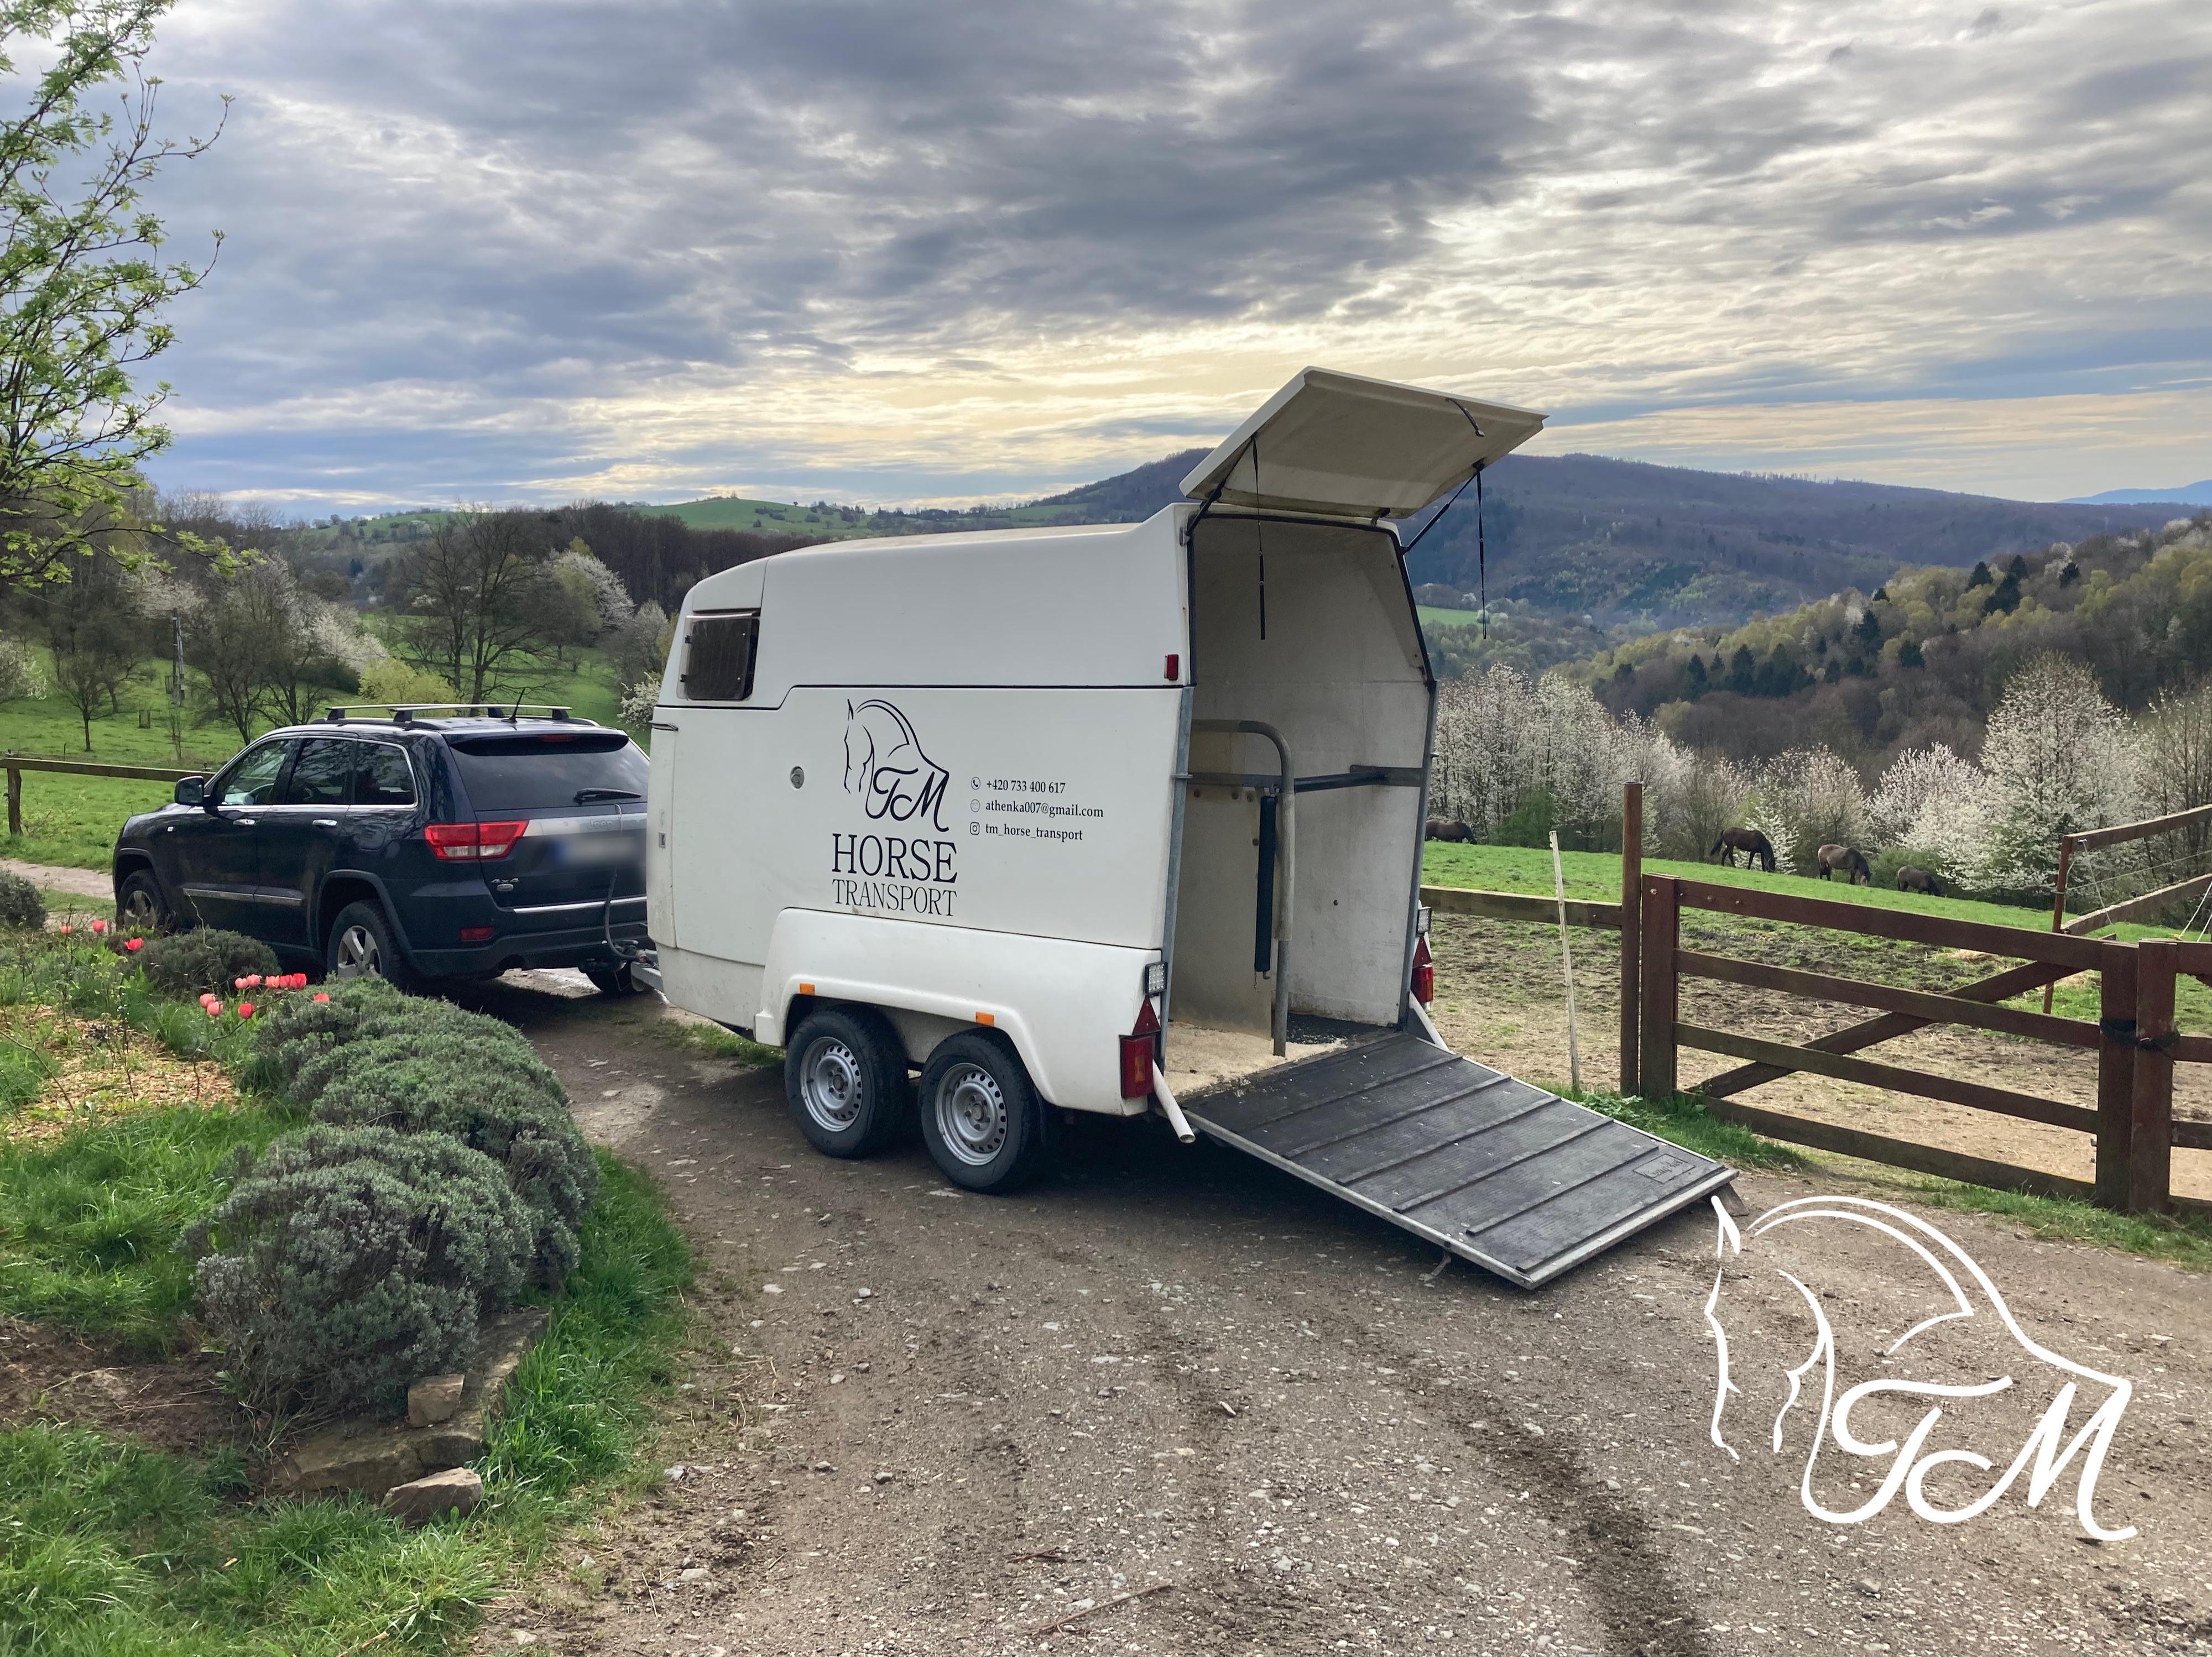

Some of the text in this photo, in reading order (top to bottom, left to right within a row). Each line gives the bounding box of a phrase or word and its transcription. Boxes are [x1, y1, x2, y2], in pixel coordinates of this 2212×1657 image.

[987, 779, 1066, 793] +420 733 400 617
[985, 799, 1104, 818] athenka007@gmail.com
[586, 819, 613, 830] Jeep
[985, 823, 1083, 843] tm_horse_transport
[832, 833, 958, 884] HORSE
[832, 879, 958, 917] TRANSPORT
